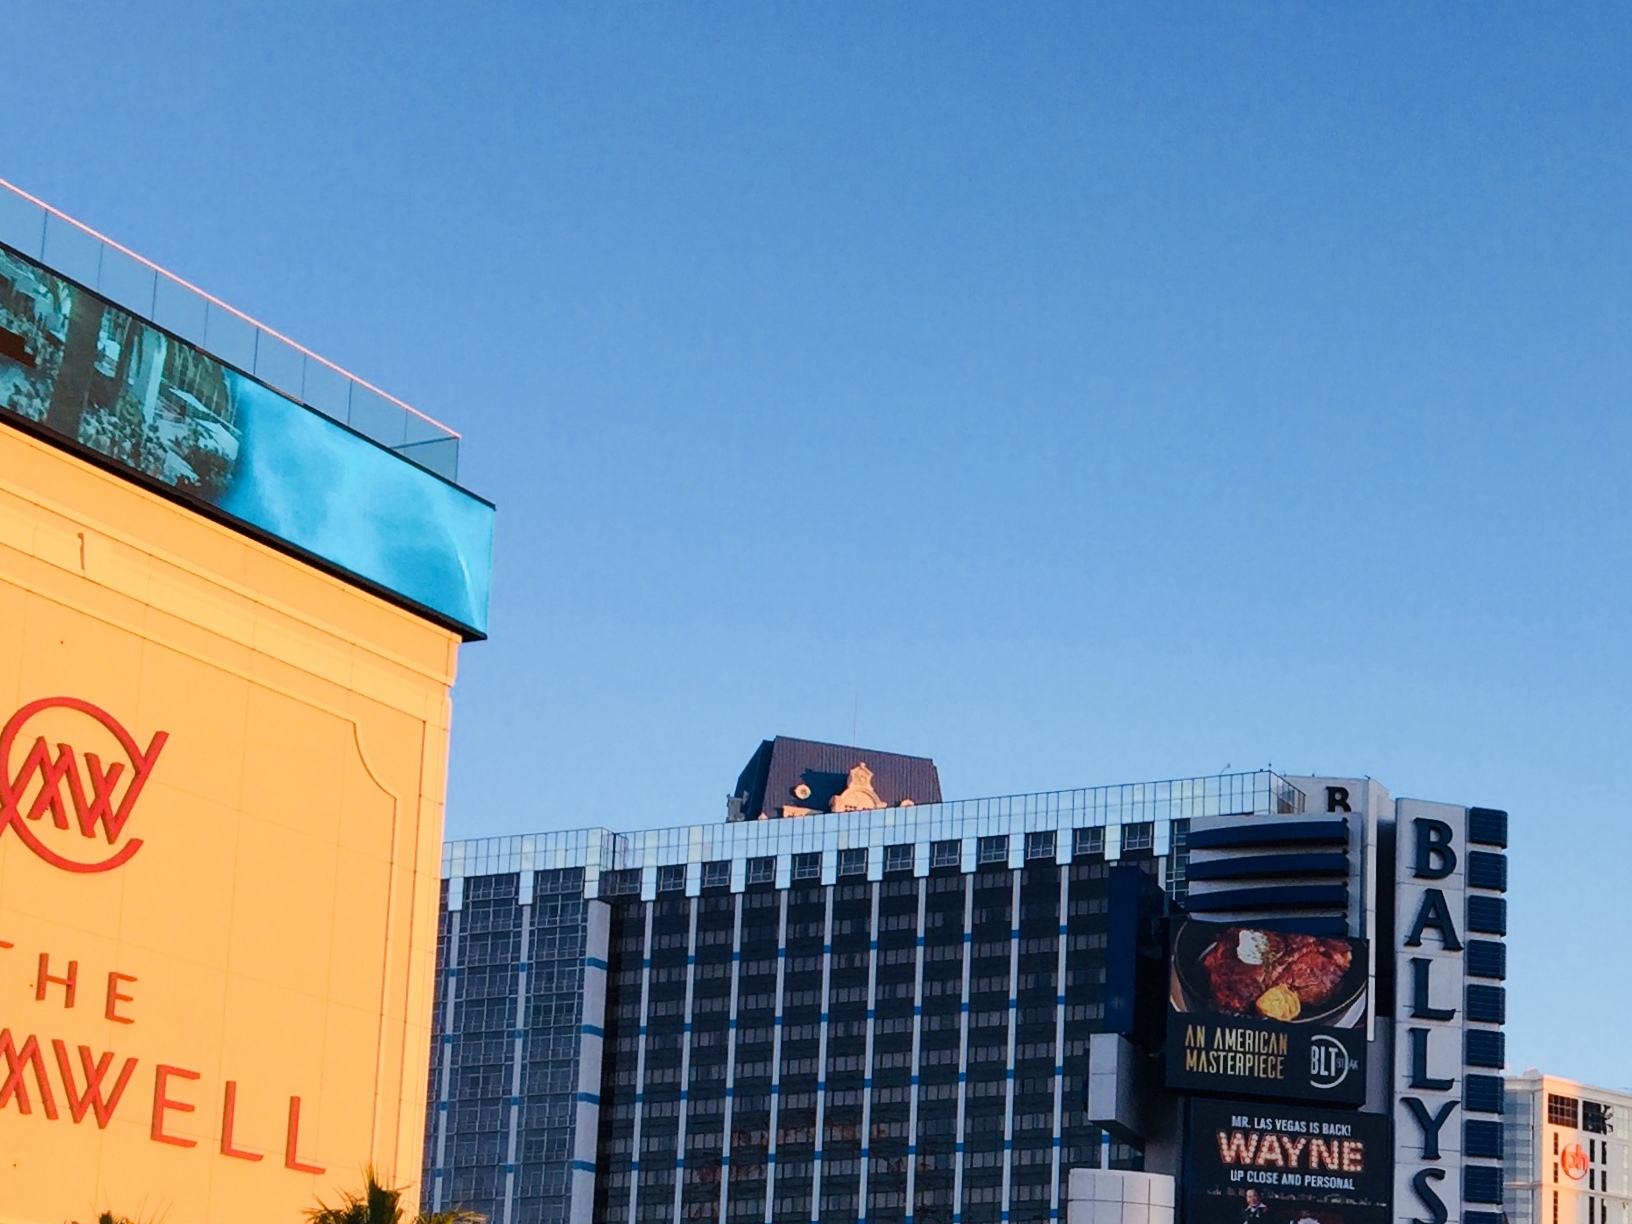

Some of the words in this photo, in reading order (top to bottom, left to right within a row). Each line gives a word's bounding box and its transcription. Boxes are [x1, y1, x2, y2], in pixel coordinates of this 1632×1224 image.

[1185, 1025, 1206, 1047] AN
[1213, 1027, 1288, 1055] AMERICAN
[1185, 1049, 1285, 1079] MASTERPIECE
[1310, 1046, 1338, 1076] BLT
[1231, 1115, 1252, 1129] MR.
[1254, 1117, 1273, 1131] LAS
[1275, 1118, 1307, 1133] VEGAS
[1309, 1122, 1320, 1134] IS
[1322, 1124, 1352, 1137] BACK!
[1217, 1130, 1365, 1172] WAYNE
[1230, 1170, 1244, 1182] UP
[1246, 1170, 1279, 1185] CLOSE
[1281, 1173, 1302, 1187] AND
[1304, 1175, 1355, 1190] PERSONAL
